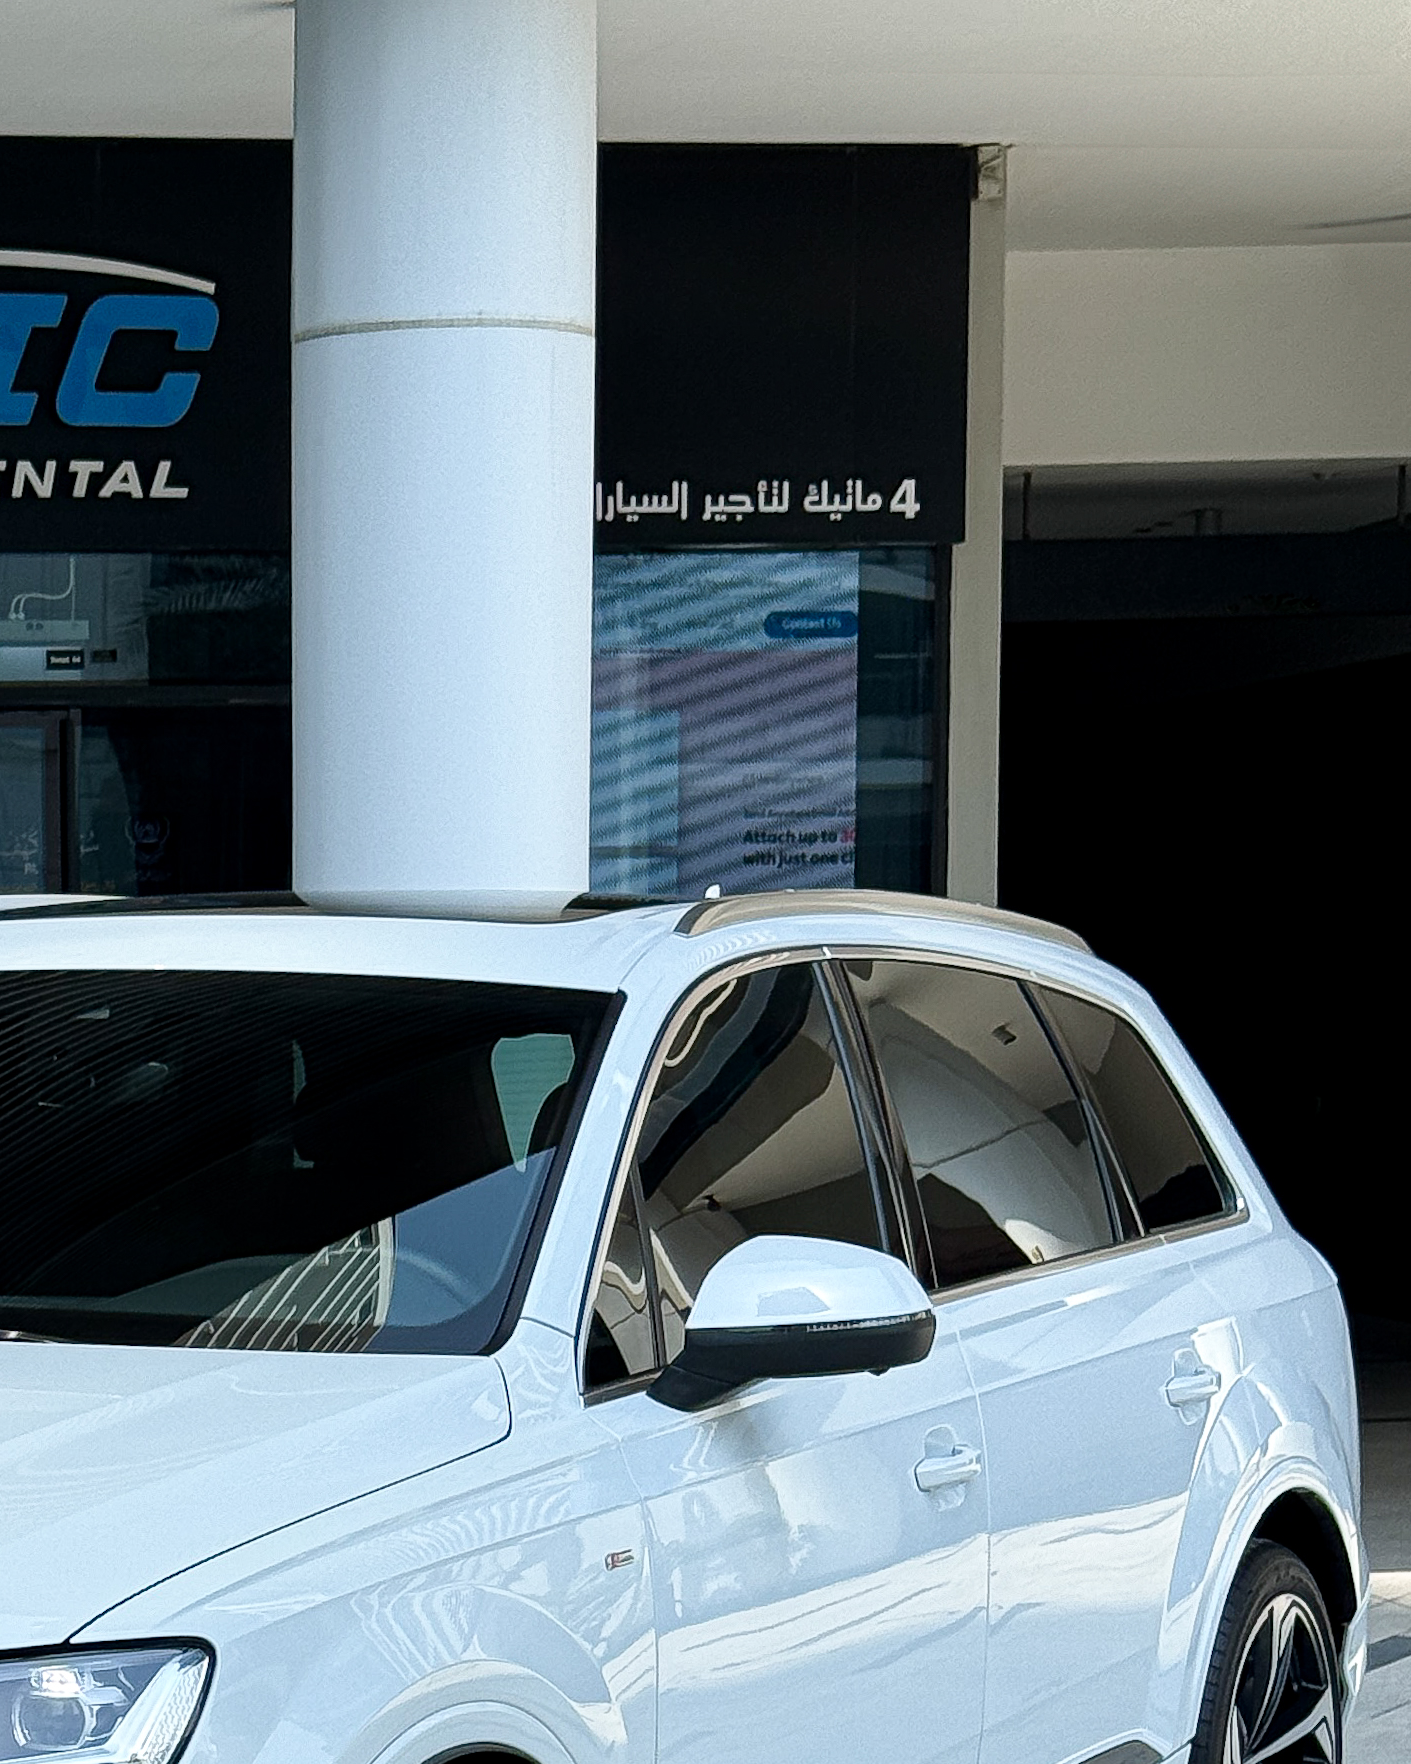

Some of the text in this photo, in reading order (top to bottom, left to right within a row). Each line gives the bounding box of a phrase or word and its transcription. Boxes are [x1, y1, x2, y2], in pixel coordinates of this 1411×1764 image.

[595, 480, 688, 522] السيارا
[701, 478, 790, 522] لتأجير
[742, 828, 797, 844] Attach
[799, 831, 819, 847] up
[820, 829, 838, 844] to
[742, 849, 776, 866] with
[777, 850, 807, 869] just
[809, 852, 839, 865] one
